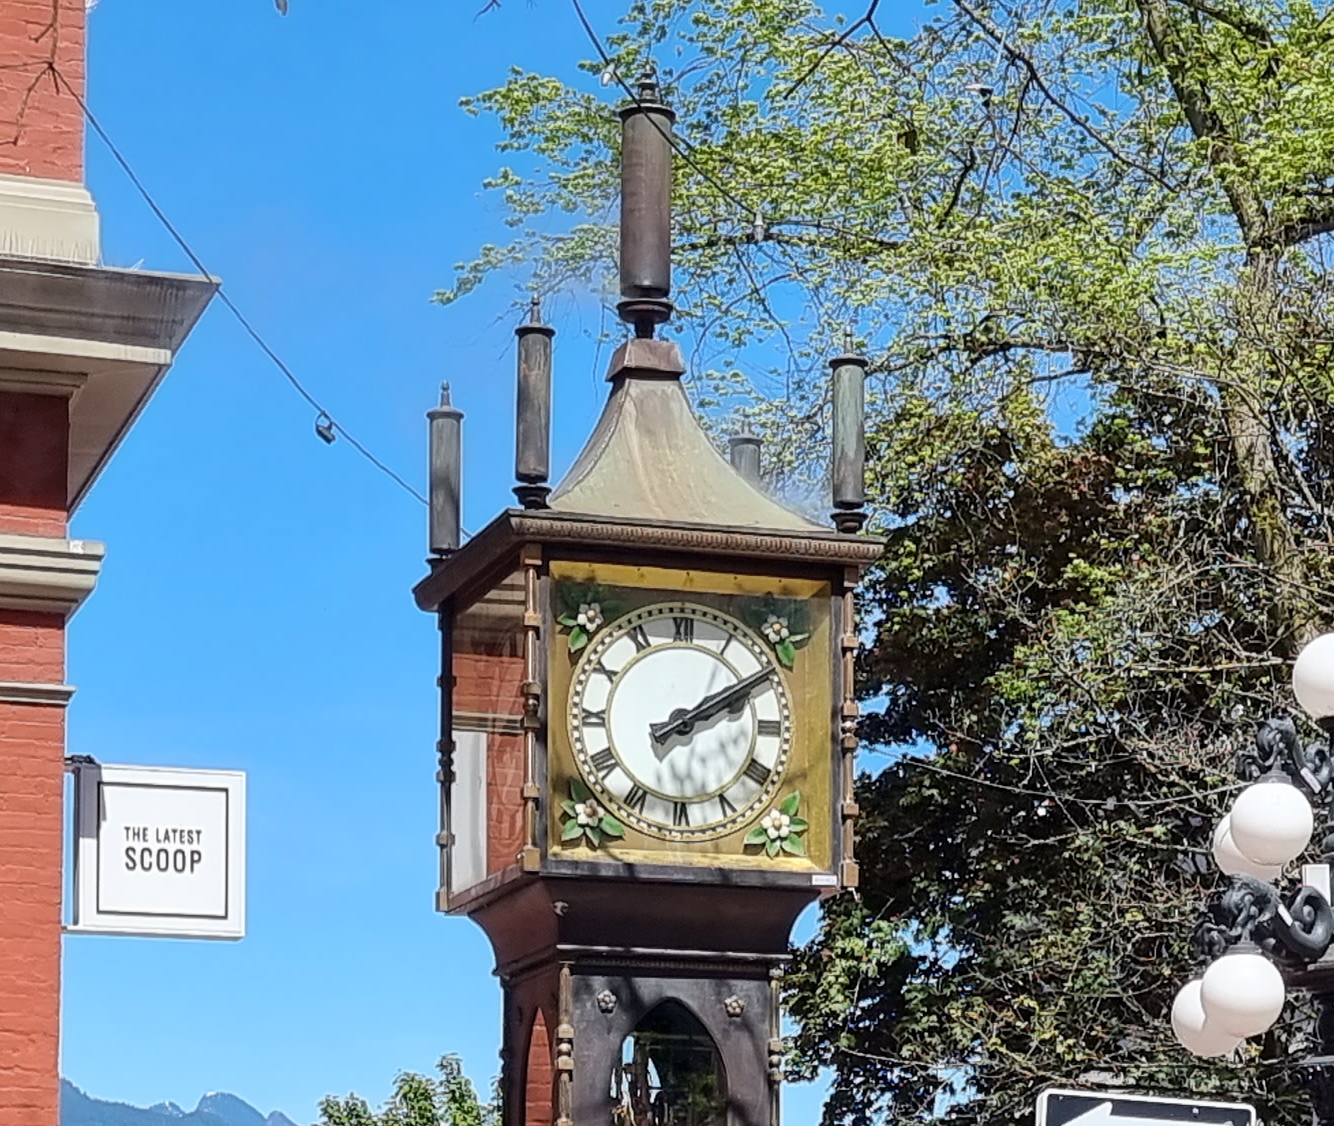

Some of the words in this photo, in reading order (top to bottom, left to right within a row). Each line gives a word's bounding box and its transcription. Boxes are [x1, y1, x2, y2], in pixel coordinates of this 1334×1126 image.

[672, 617, 694, 644] XII
[757, 719, 782, 737] III
[124, 826, 149, 843] THE
[156, 827, 203, 846] LATEST
[125, 846, 202, 875] SCOOP
